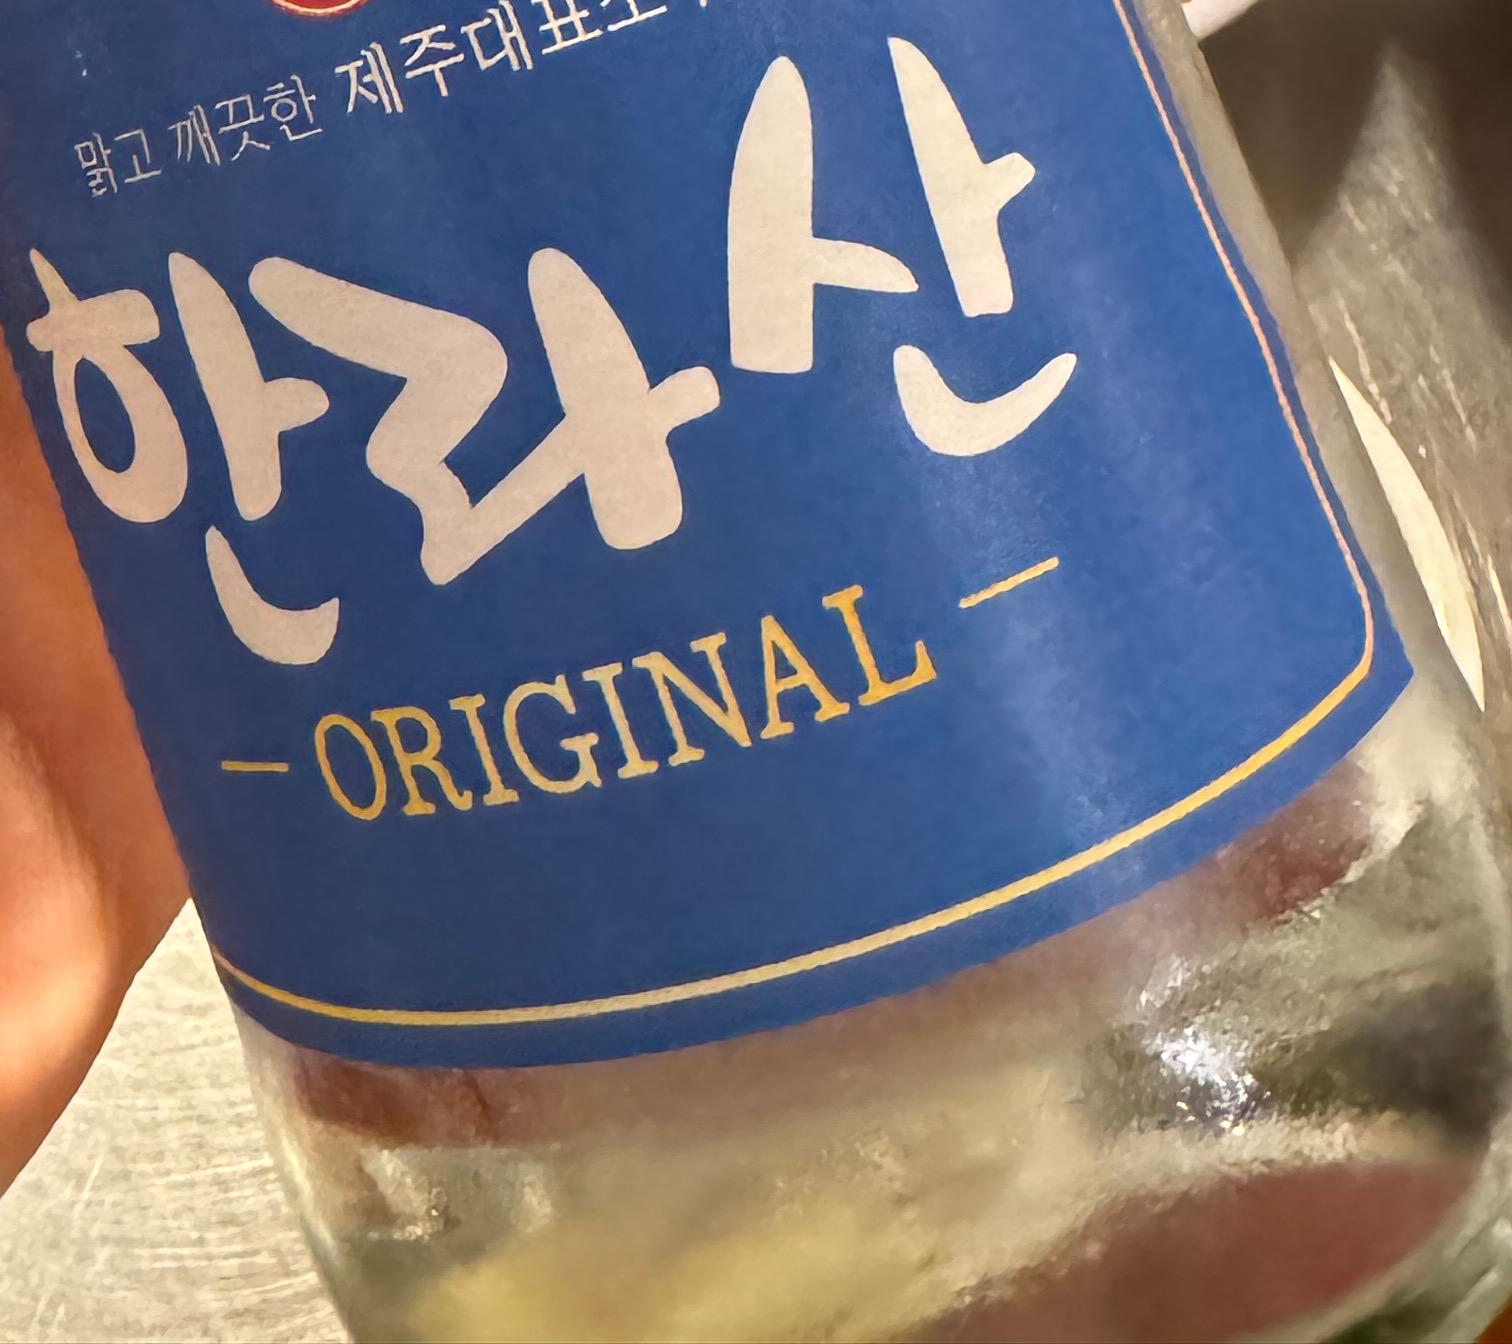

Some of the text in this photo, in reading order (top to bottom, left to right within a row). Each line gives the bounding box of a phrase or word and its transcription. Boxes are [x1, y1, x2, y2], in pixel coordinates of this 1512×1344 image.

[74, 127, 163, 199] 맑고
[167, 74, 323, 168] 깨끗한
[25, 36, 1077, 666] 한라산
[313, 583, 937, 821] ORIGINAL
